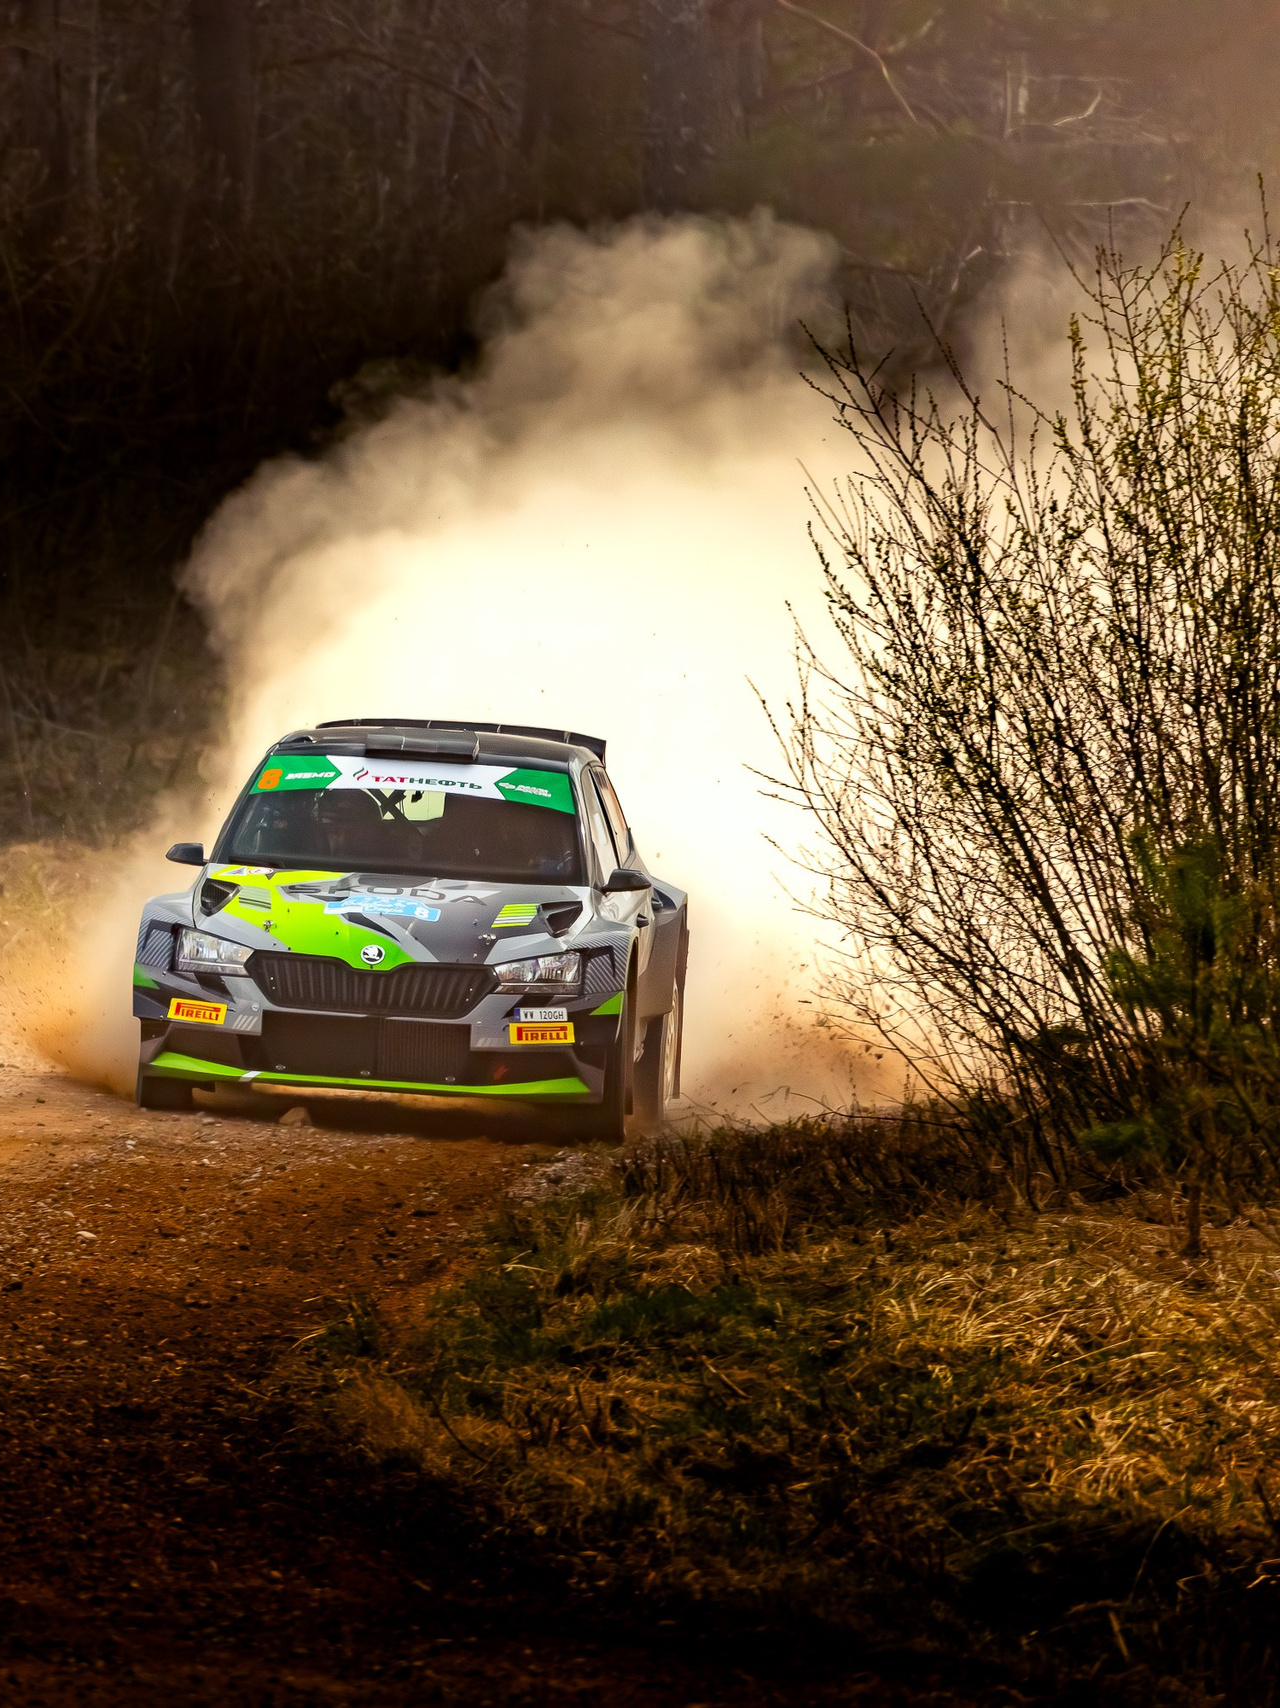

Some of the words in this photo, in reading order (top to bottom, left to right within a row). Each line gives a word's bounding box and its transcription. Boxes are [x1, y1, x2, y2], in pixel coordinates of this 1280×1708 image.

[257, 768, 283, 789] 8
[372, 775, 482, 790] ТАТНЕФТЬ
[414, 906, 429, 919] 8
[174, 1002, 221, 1021] PIRELLI
[539, 1010, 564, 1020] 120GH
[516, 1026, 567, 1041] PIRELLI
